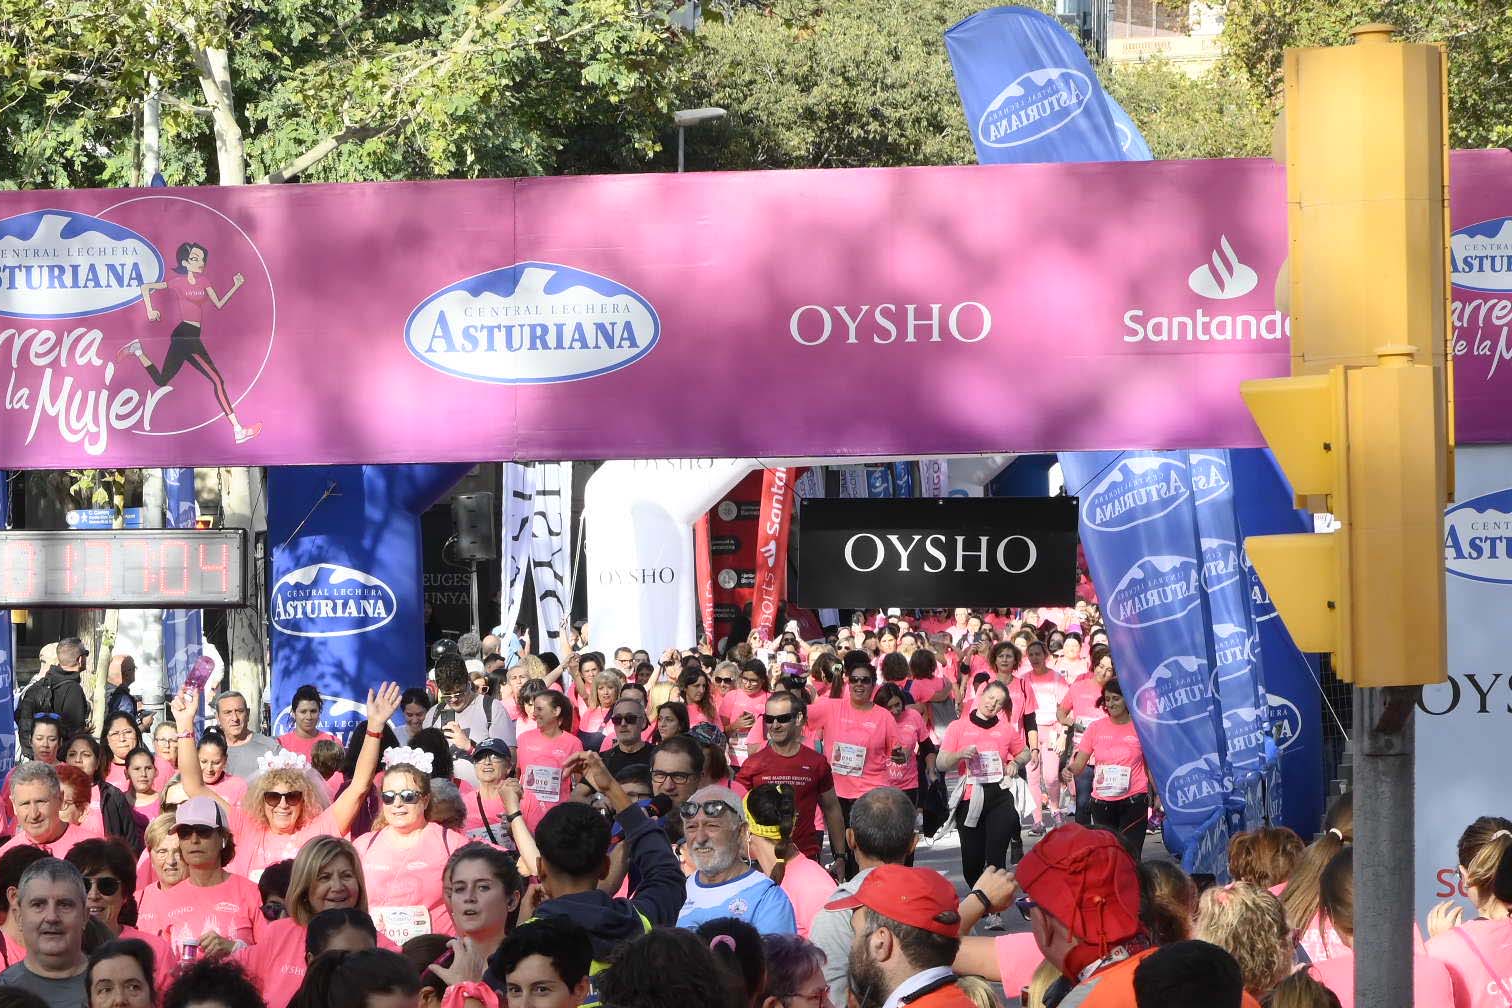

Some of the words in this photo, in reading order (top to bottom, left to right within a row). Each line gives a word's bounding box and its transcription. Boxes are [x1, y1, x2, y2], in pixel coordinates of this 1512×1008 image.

[67, 246, 139, 257] LECHERA
[464, 304, 542, 317] CENTRAL
[550, 302, 632, 315] LECHERA
[1452, 298, 1512, 327] arre
[424, 309, 640, 353] ASTURIANA
[790, 301, 992, 346] OYSHO
[1123, 308, 1289, 342] Santand
[1473, 329, 1491, 355] la
[5, 371, 30, 411] la
[25, 362, 174, 455] Mujer
[1471, 521, 1512, 531] CENT
[844, 533, 1038, 574] OYSHO
[599, 567, 675, 585] OYSHO
[287, 588, 327, 598] CENTRAL
[333, 586, 382, 597] LECHERA
[275, 594, 387, 621] ASTURIANA
